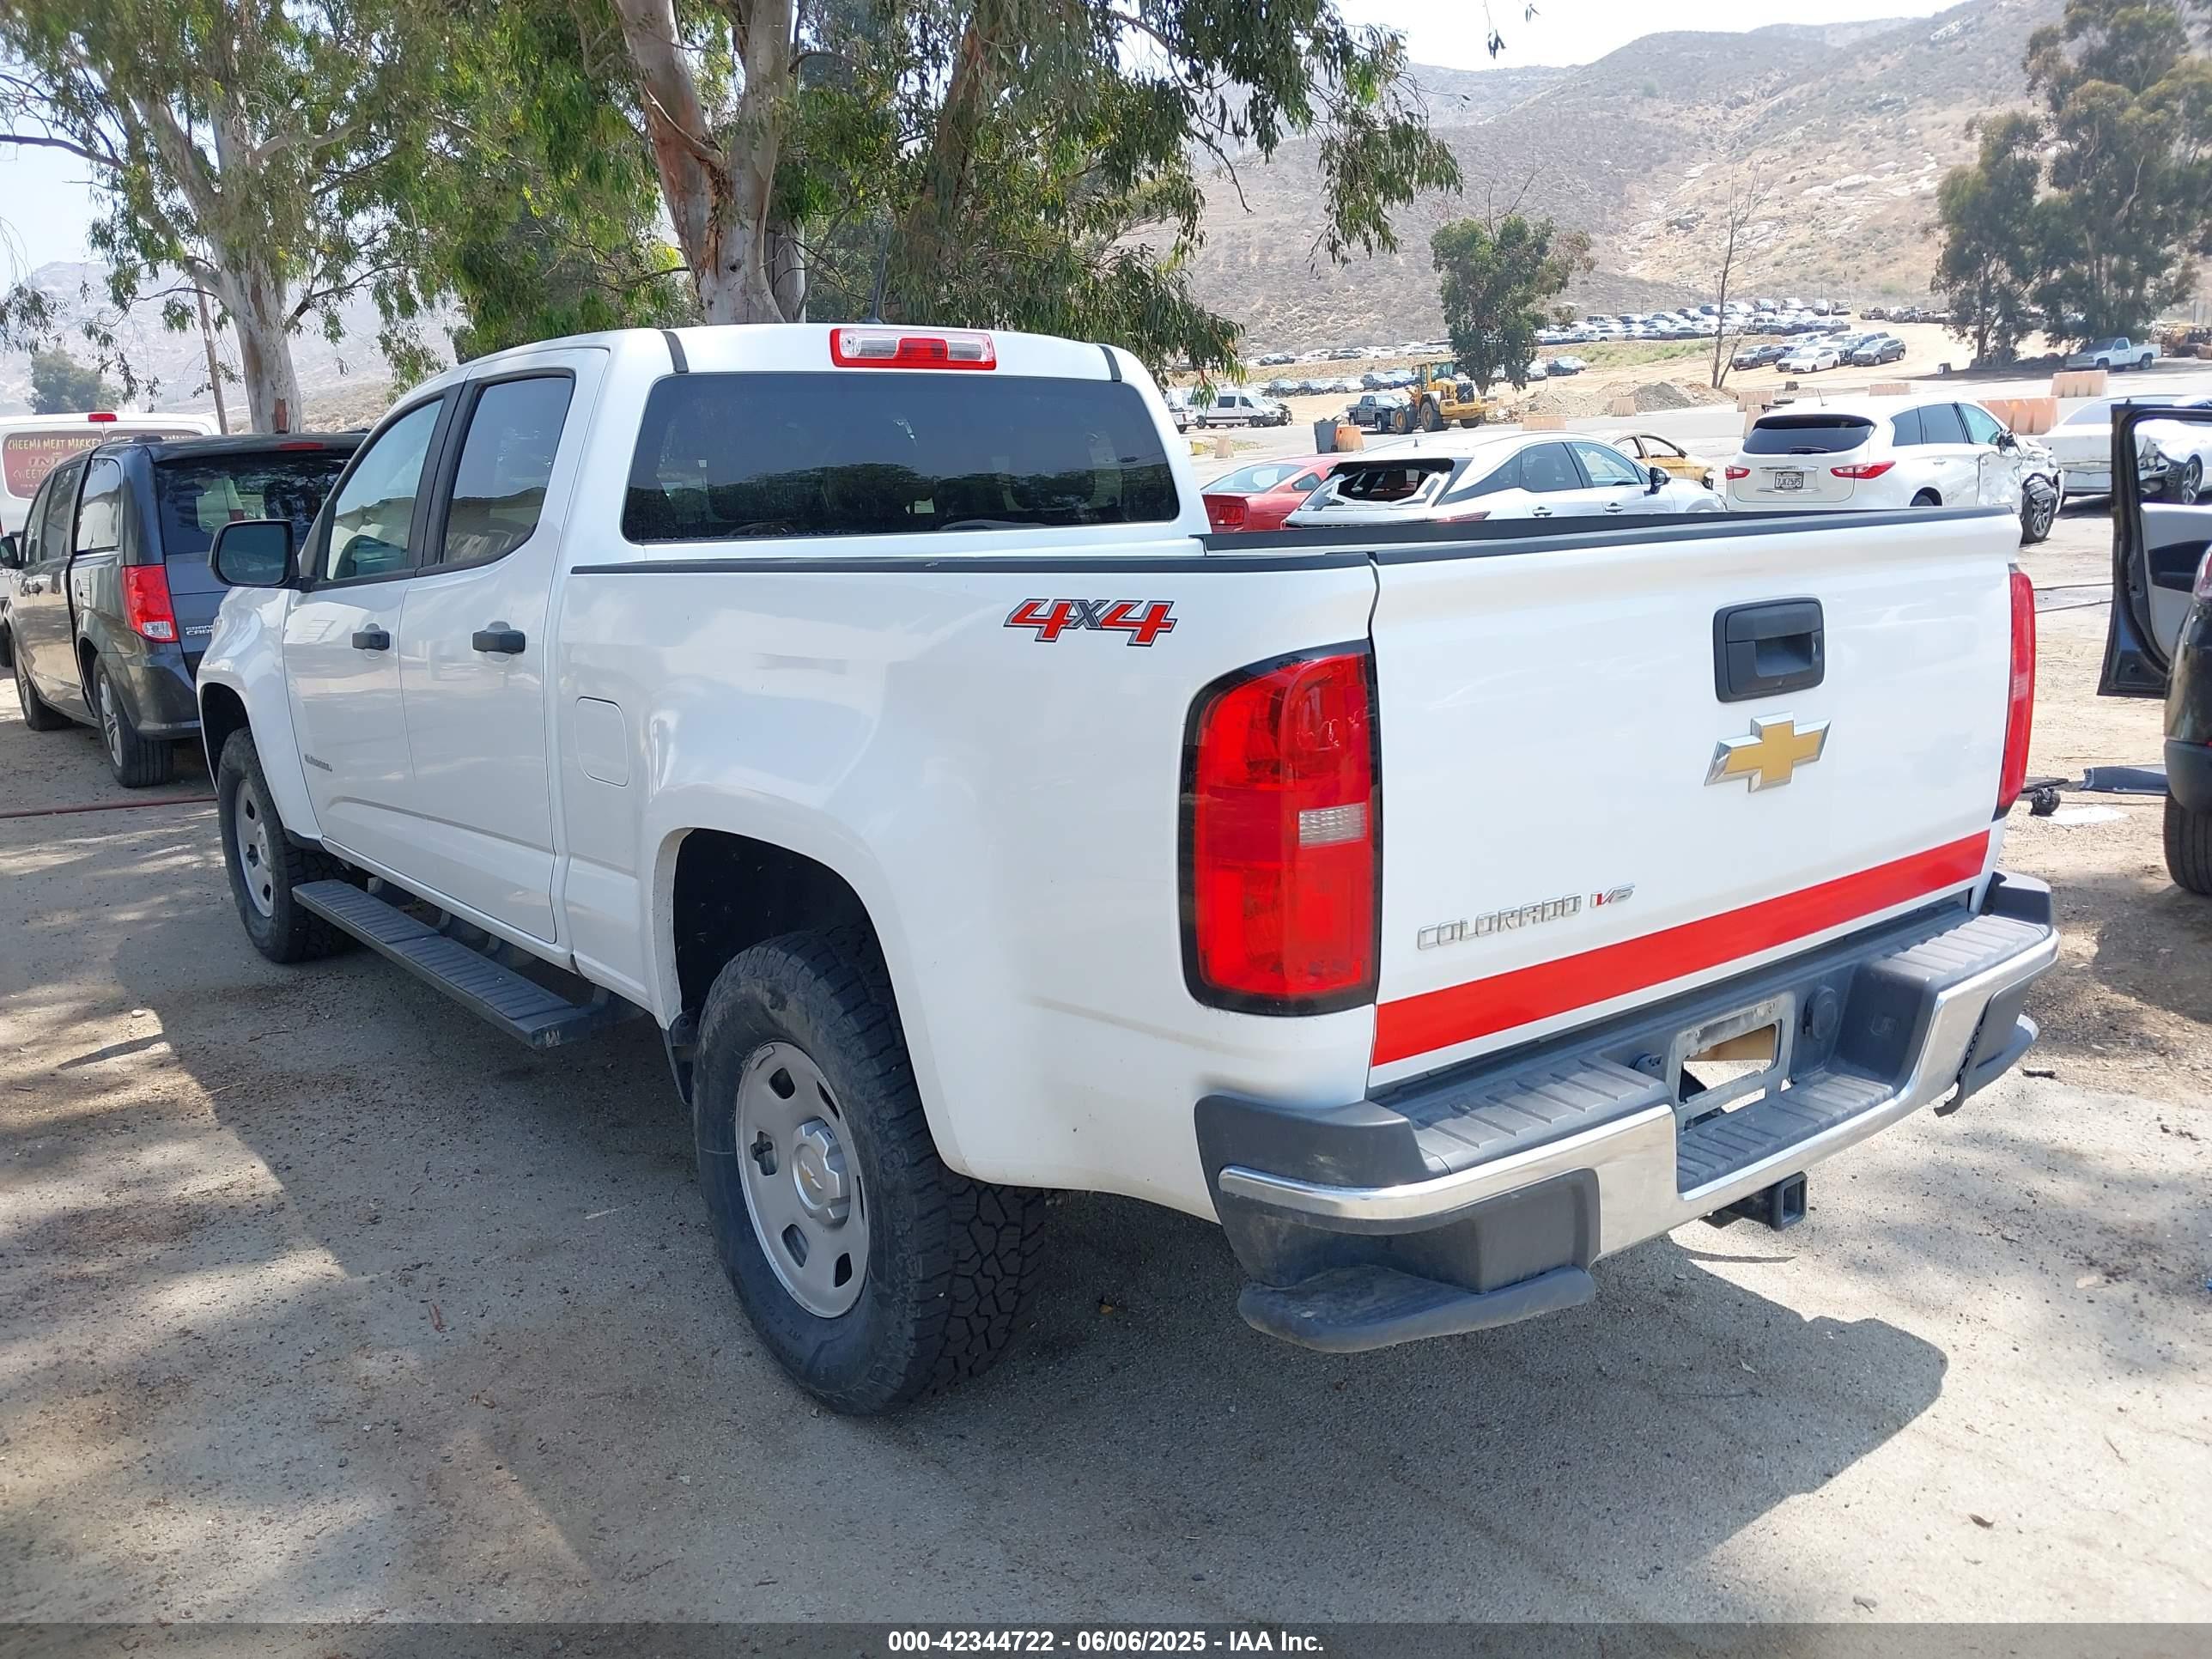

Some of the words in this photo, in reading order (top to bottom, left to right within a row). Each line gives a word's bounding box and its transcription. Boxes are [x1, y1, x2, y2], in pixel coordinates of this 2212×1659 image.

[8, 438, 41, 451] CHEEMA
[44, 438, 66, 451] MEAT
[69, 438, 103, 450] MARKET
[1417, 893, 1582, 951] COLORADO
[1590, 883, 1635, 908] V6
